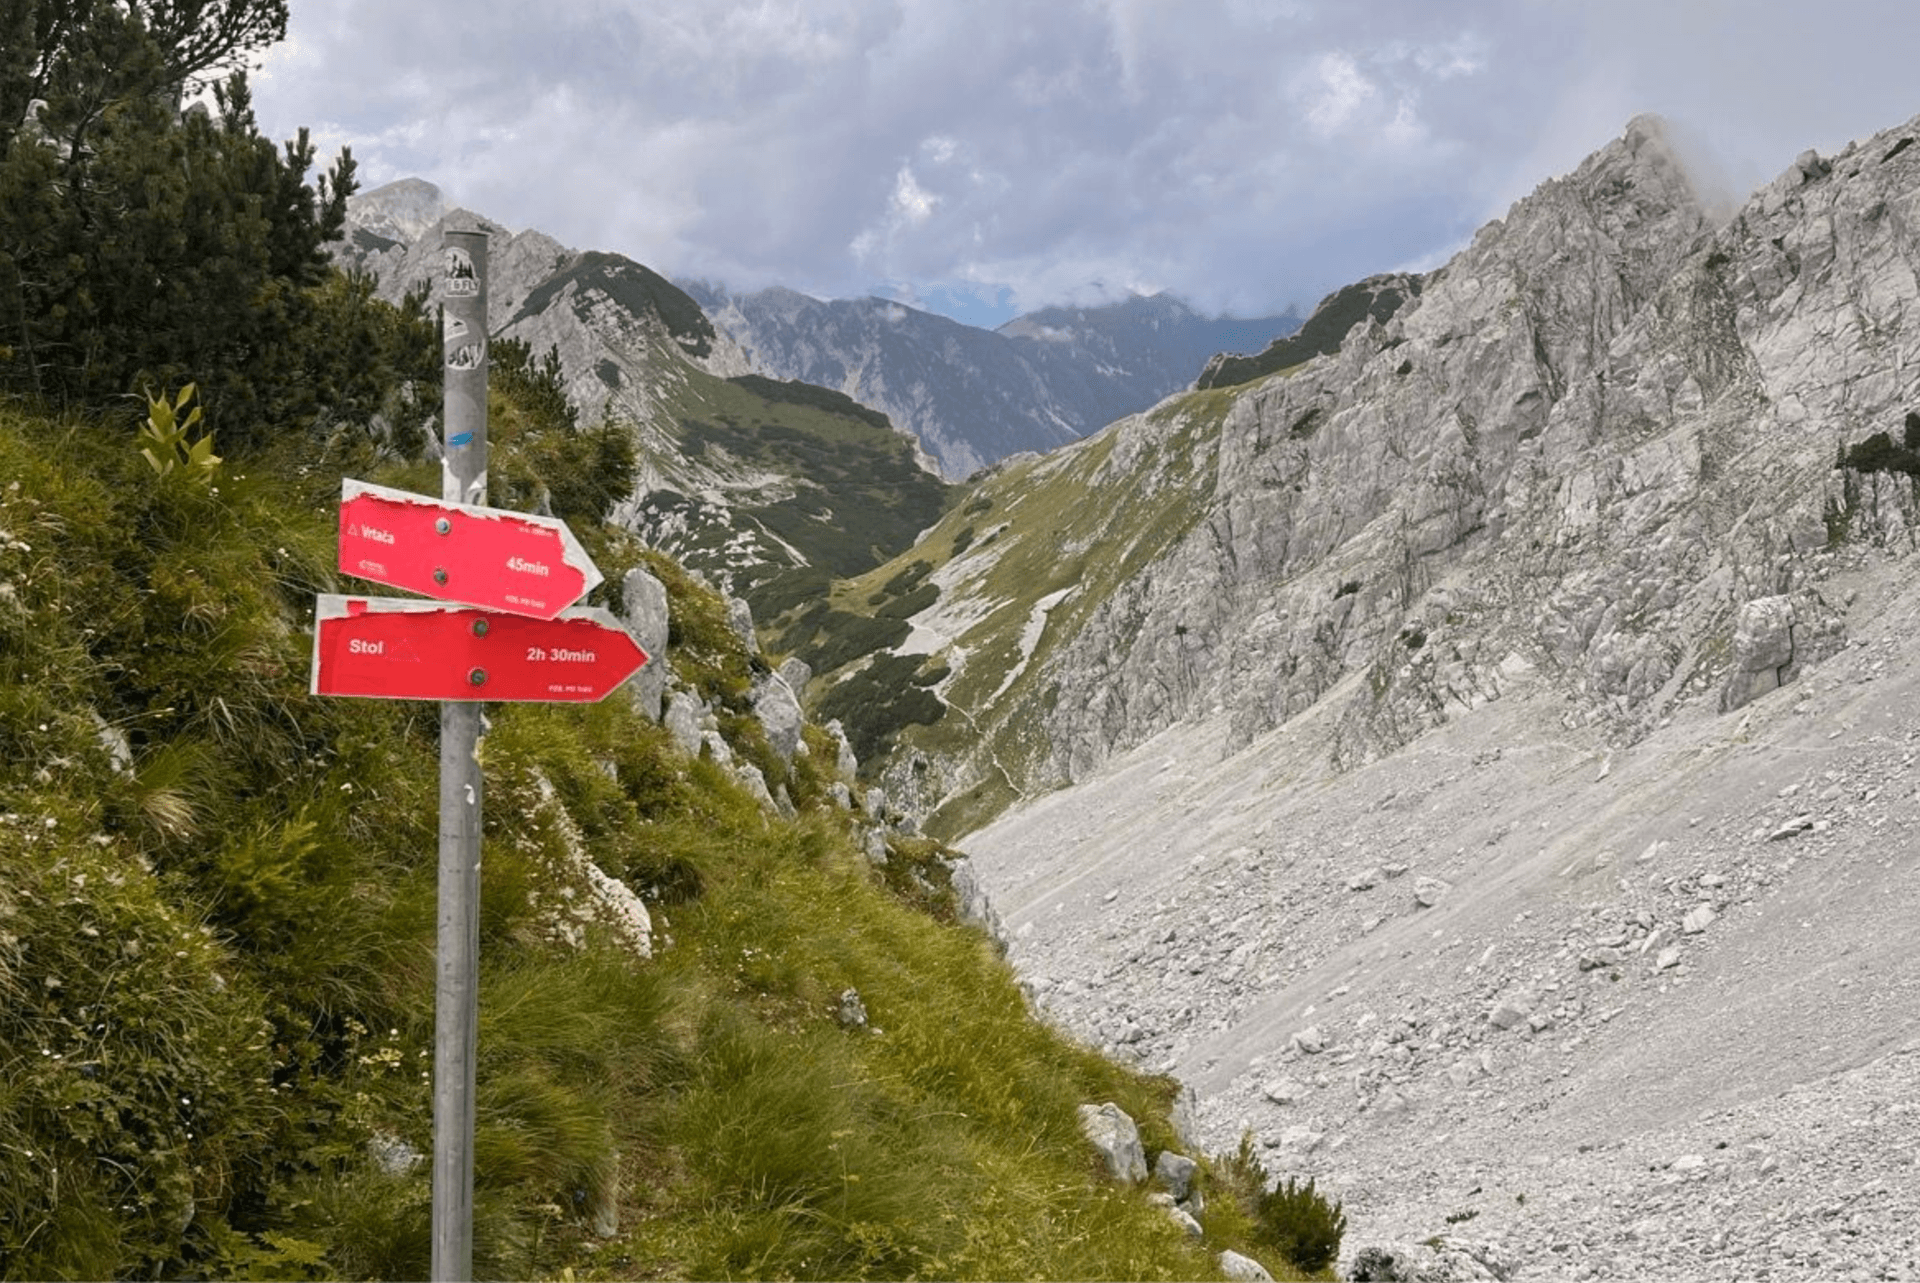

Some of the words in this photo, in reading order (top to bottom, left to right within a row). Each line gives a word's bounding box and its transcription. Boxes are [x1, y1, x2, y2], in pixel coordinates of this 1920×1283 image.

[506, 556, 549, 577] 45min
[350, 639, 384, 655] Stol
[526, 646, 546, 661] 2h
[550, 648, 596, 663] 30min
